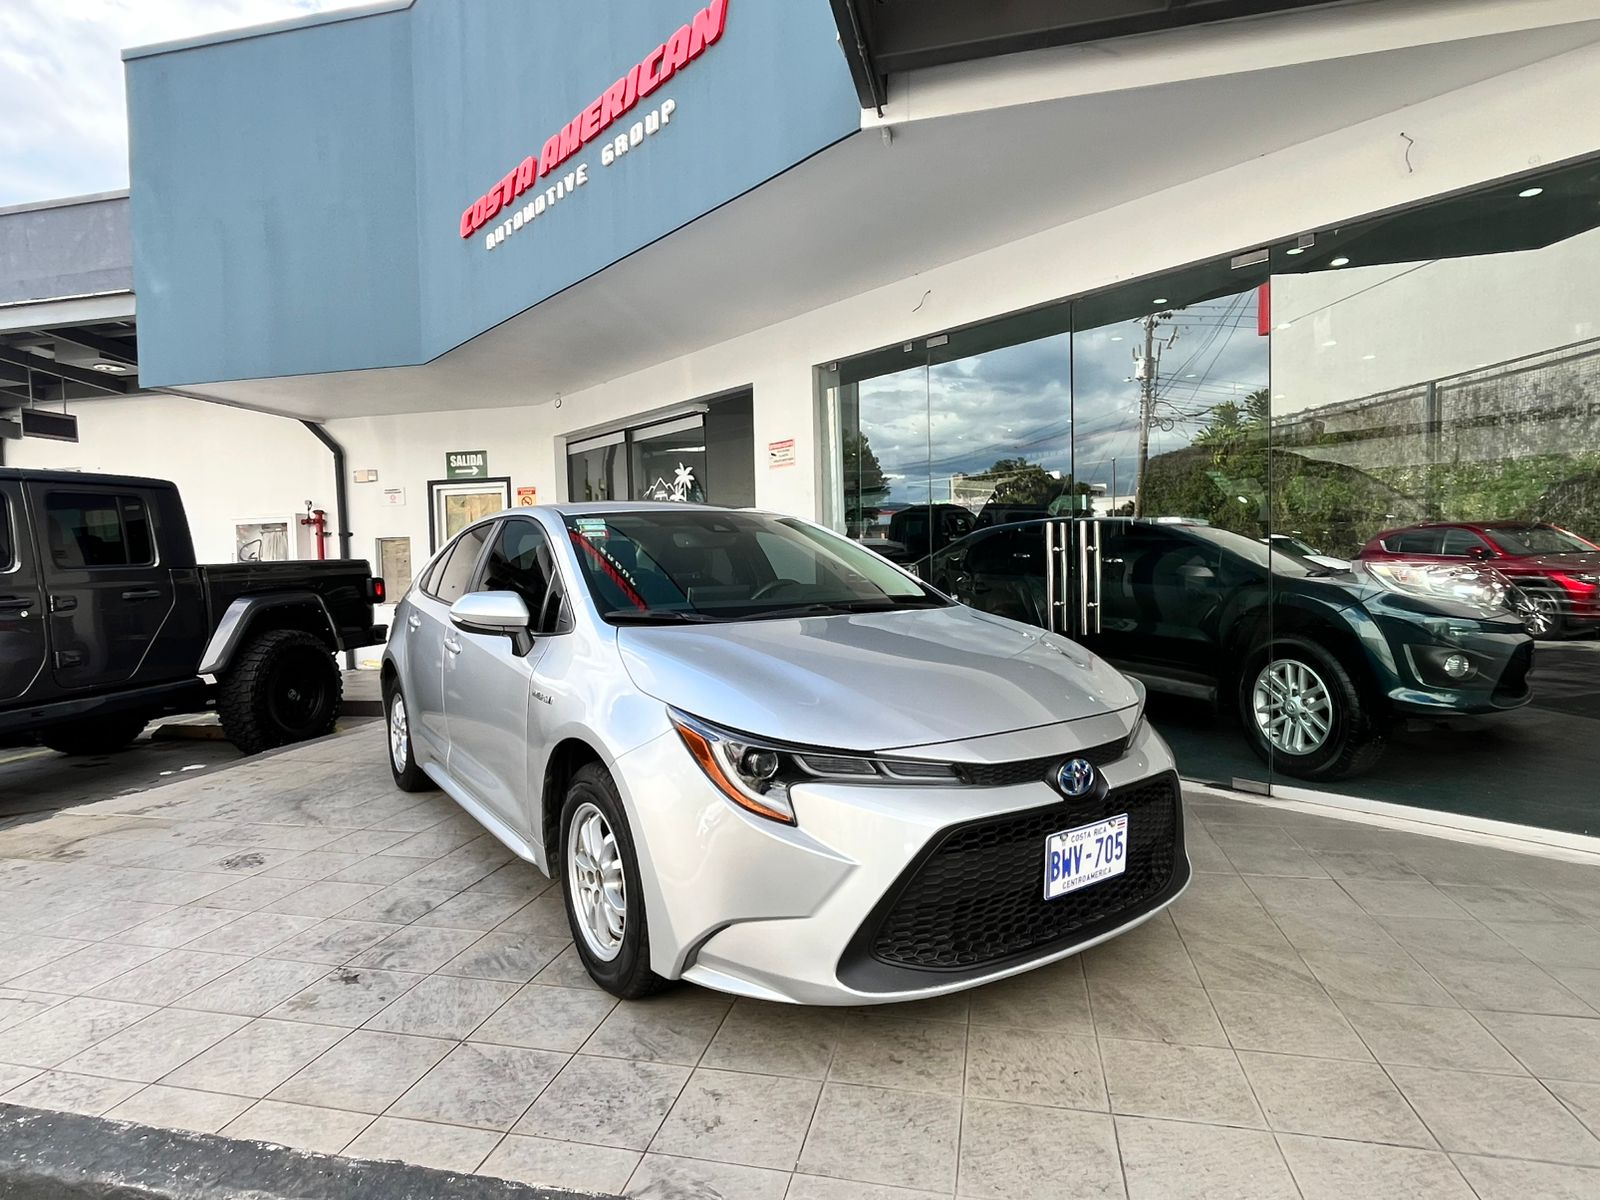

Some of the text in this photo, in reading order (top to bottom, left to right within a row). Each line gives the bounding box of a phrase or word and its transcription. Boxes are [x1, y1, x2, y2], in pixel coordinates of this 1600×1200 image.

[460, 0, 729, 238] COSTA AMERICAN
[486, 98, 676, 250] AUTOMOTIVE GROUP
[450, 454, 483, 467] SALIDA
[1071, 826, 1107, 843] COSTA RICA
[1050, 831, 1124, 882] BWV-705
[1062, 867, 1112, 889] CENTROAMERICA
